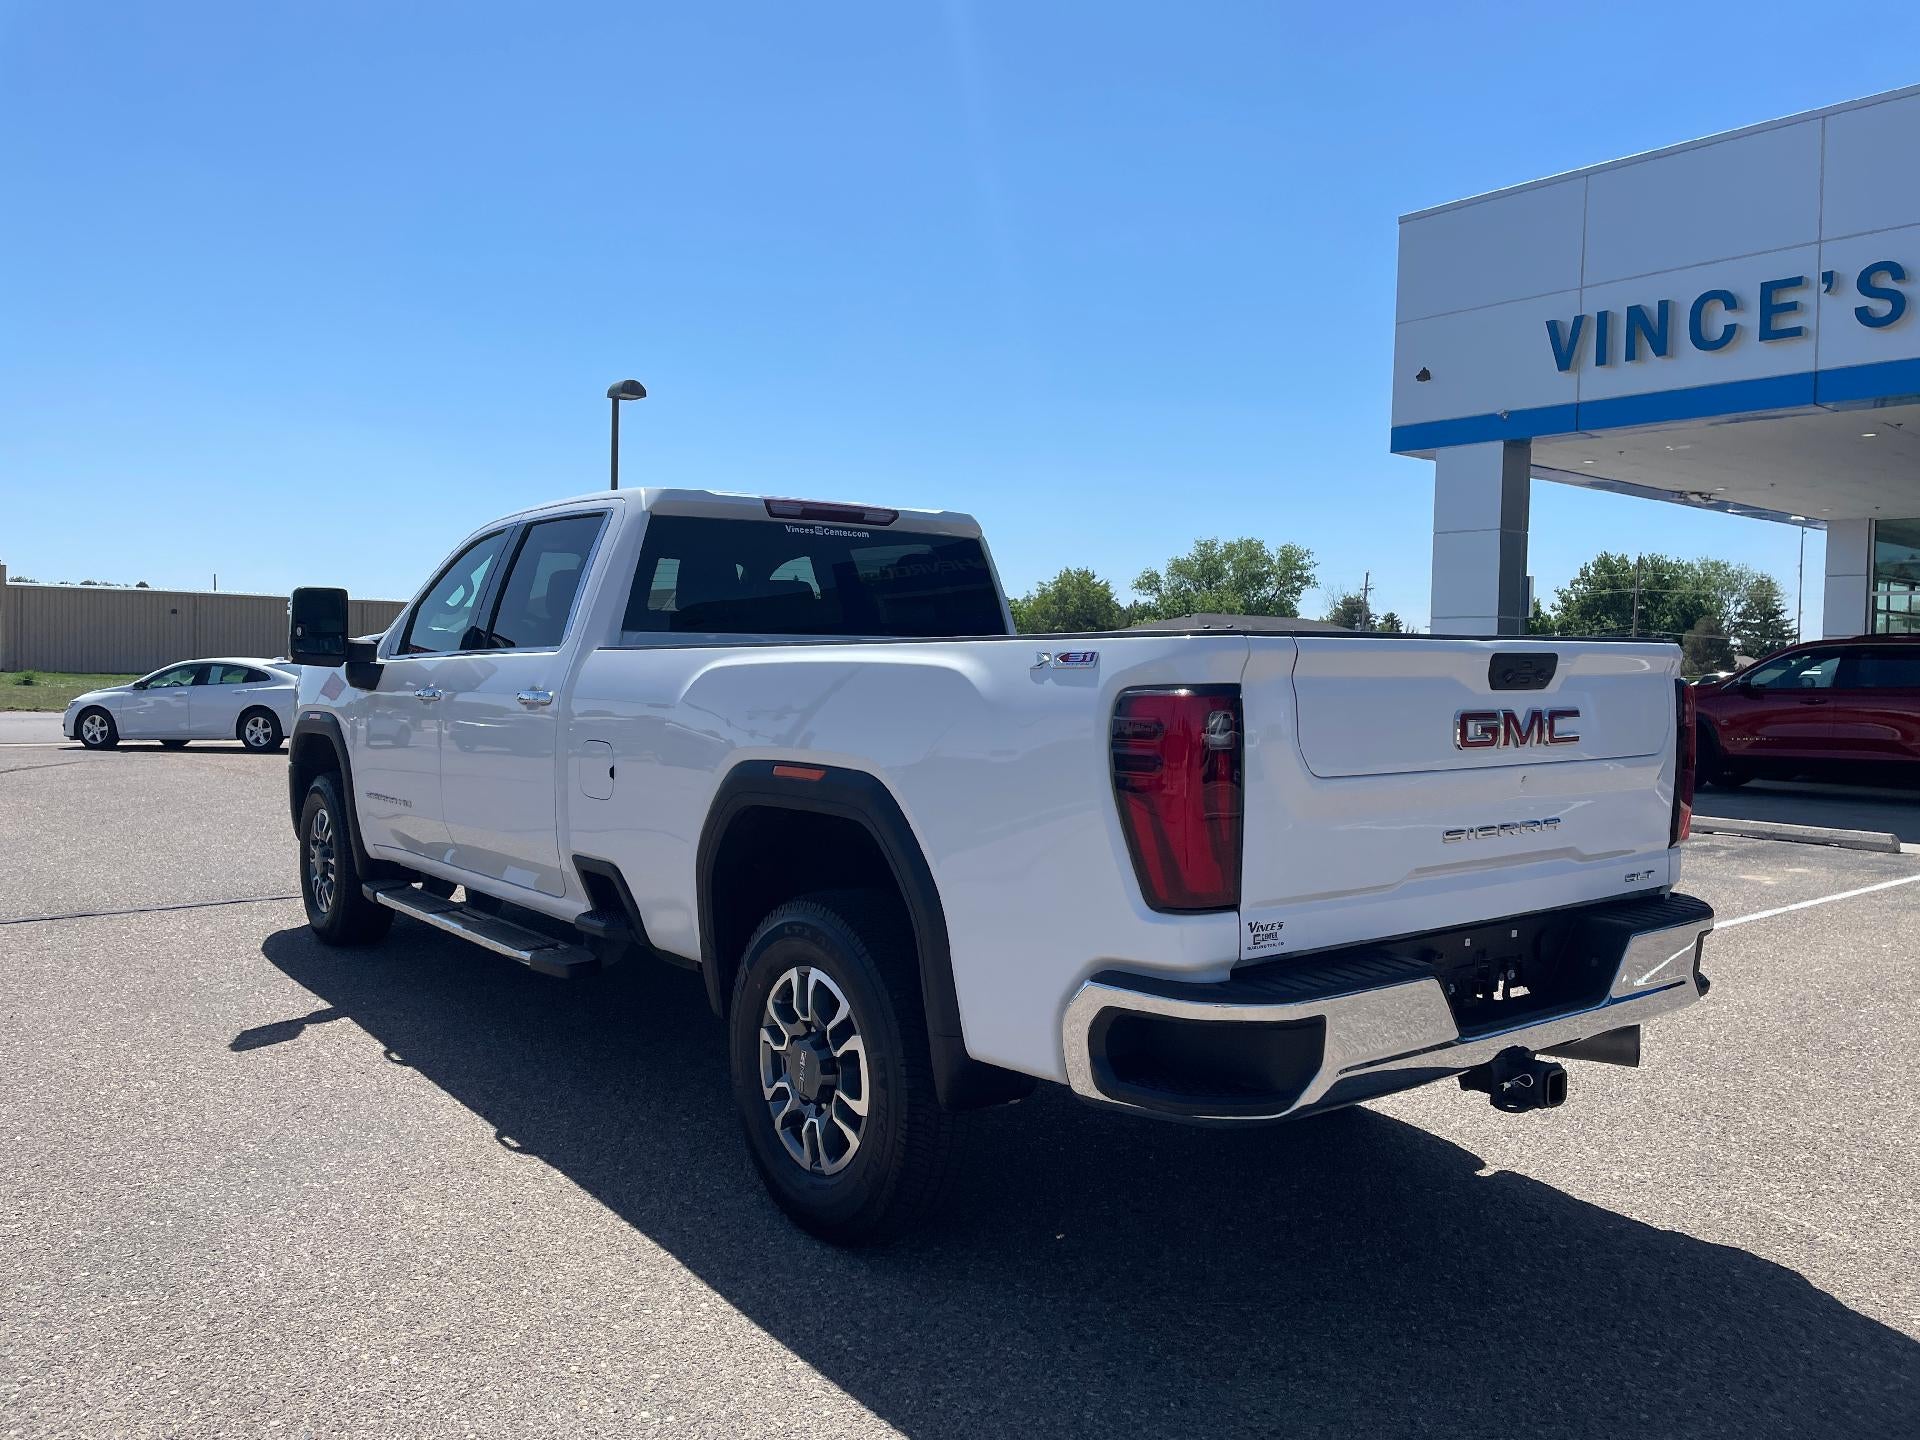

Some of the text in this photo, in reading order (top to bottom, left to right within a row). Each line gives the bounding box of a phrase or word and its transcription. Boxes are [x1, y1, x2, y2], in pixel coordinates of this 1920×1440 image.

[1545, 260, 1908, 373] VINCE'S
[1454, 707, 1581, 750] GMC
[1442, 817, 1561, 844] SIERRA
